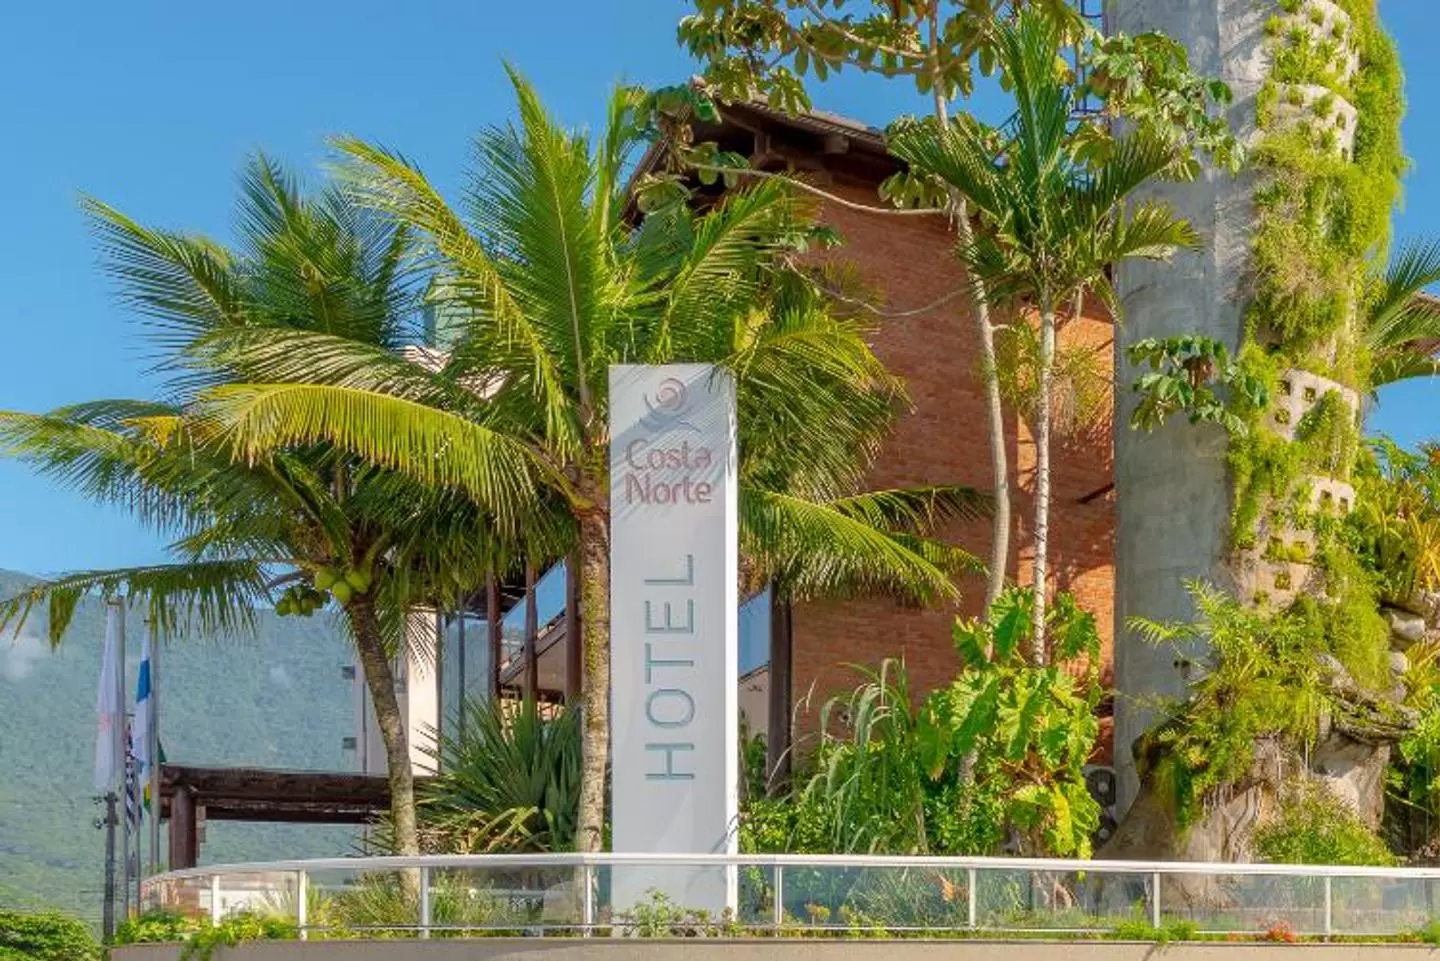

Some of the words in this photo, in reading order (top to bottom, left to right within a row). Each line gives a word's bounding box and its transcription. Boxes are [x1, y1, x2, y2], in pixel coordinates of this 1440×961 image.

[625, 439, 712, 470] Costa
[624, 472, 712, 504] Norte
[645, 554, 695, 782] HOTEL
